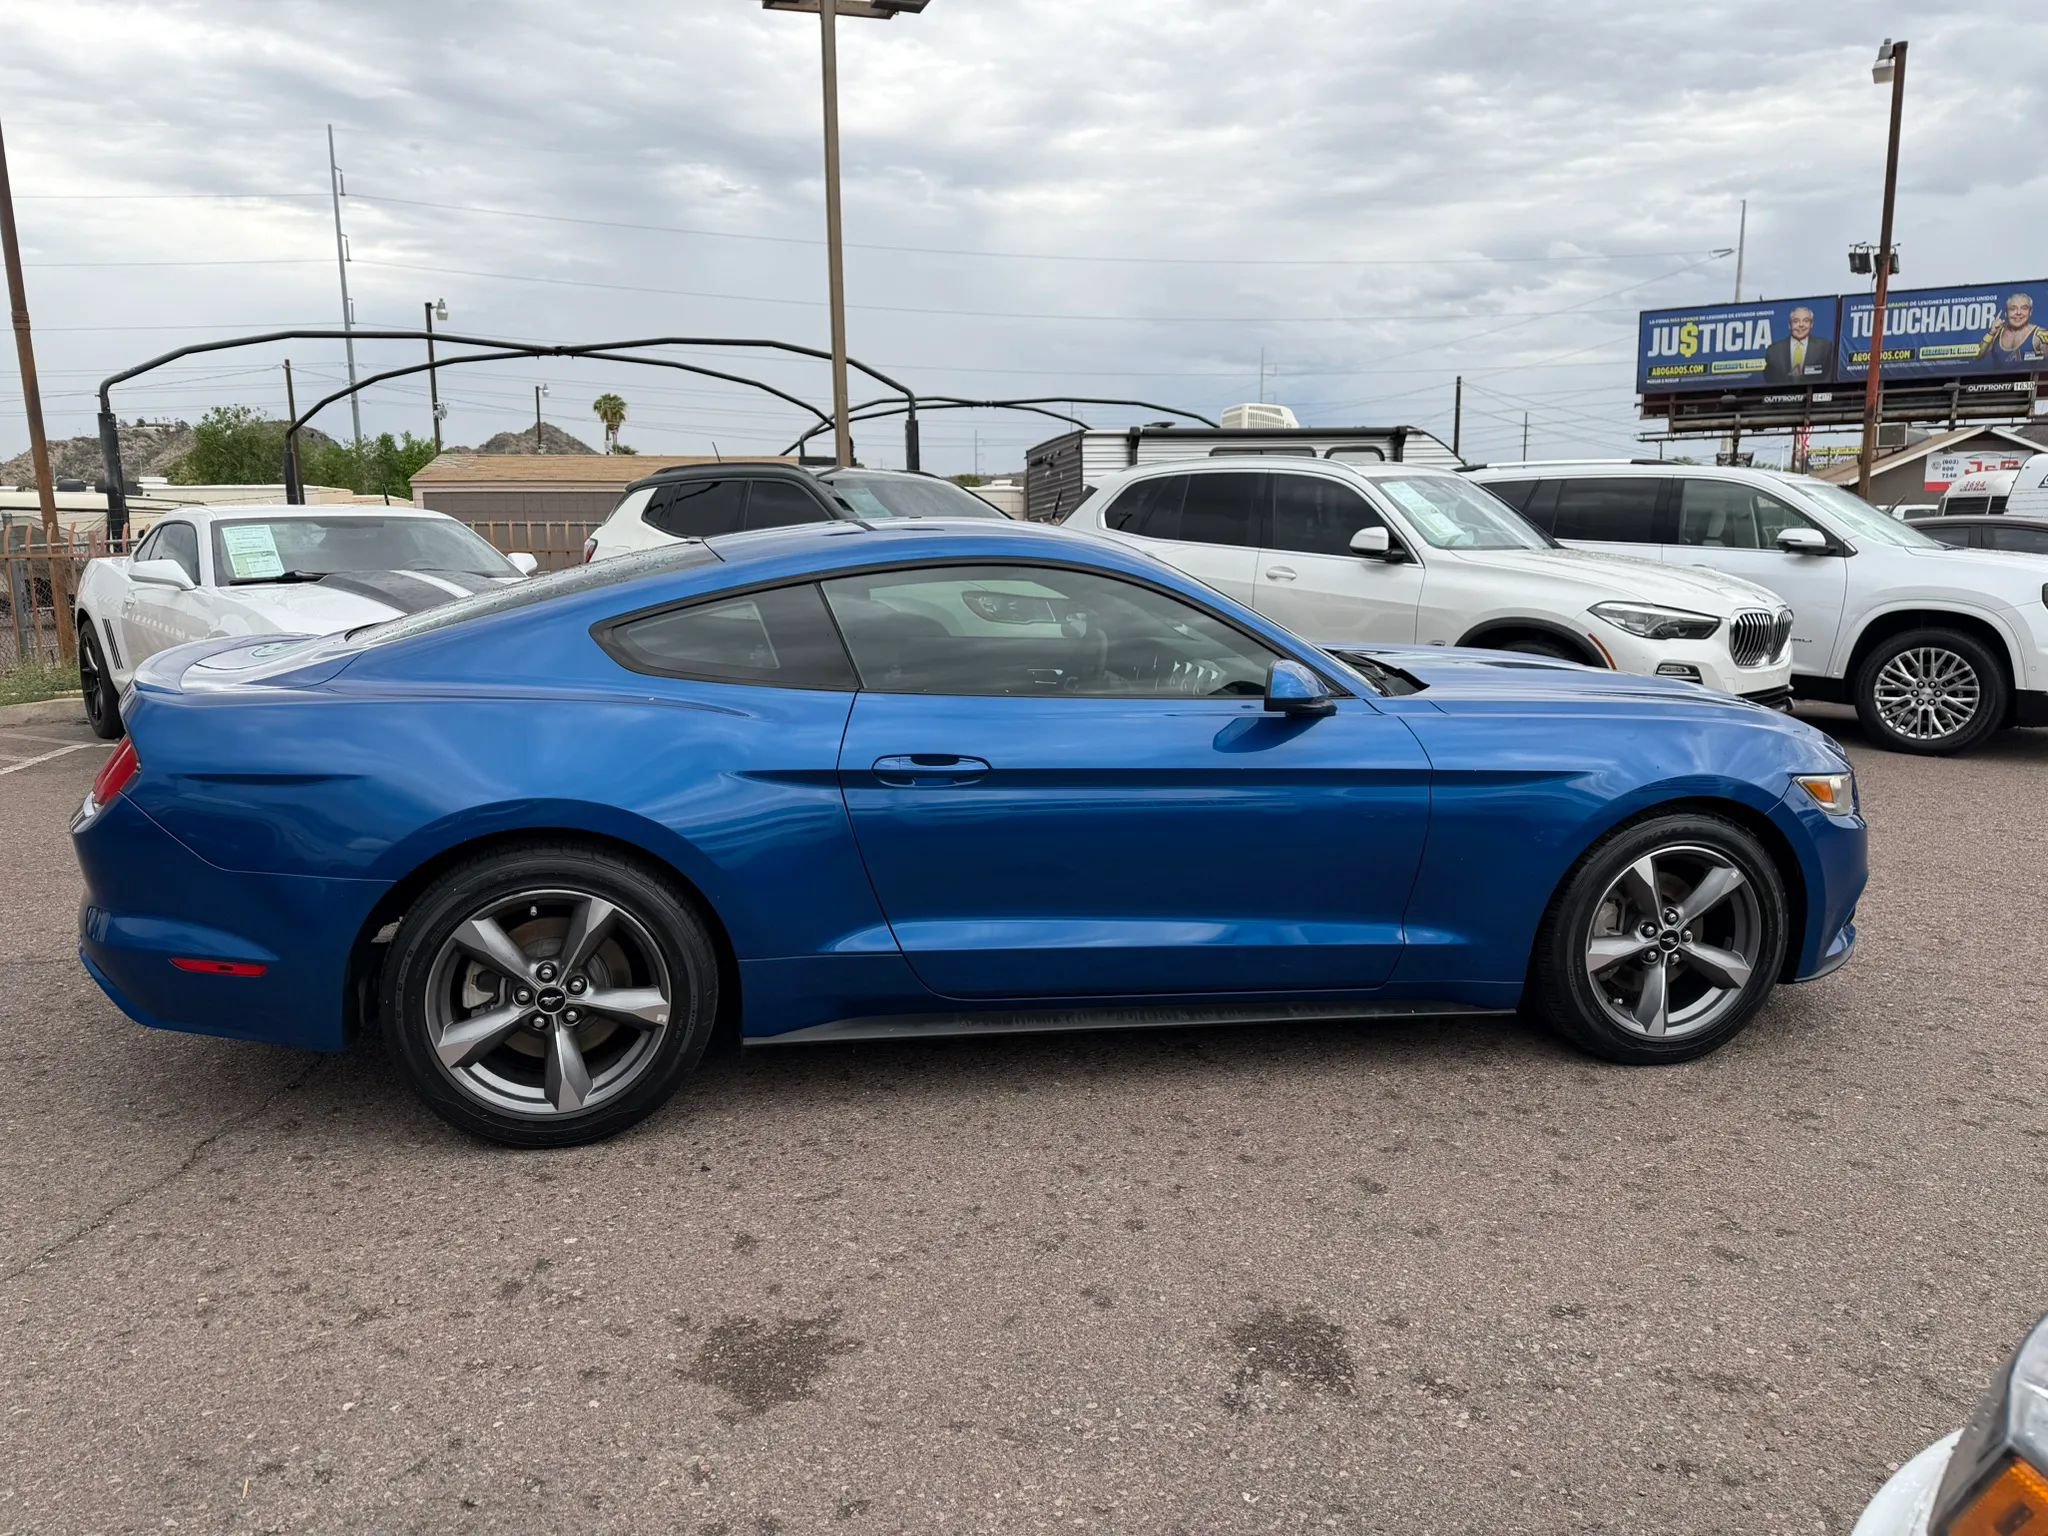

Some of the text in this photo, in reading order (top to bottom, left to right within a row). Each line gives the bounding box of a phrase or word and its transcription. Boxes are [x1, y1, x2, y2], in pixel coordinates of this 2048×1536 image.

[1851, 303, 1997, 338] TU LUCHADOR
[1647, 319, 1772, 358] JU$TICIA
[1852, 350, 1911, 362] ABOGOS.COM
[1651, 364, 1704, 376] ABOGADOS.COM
